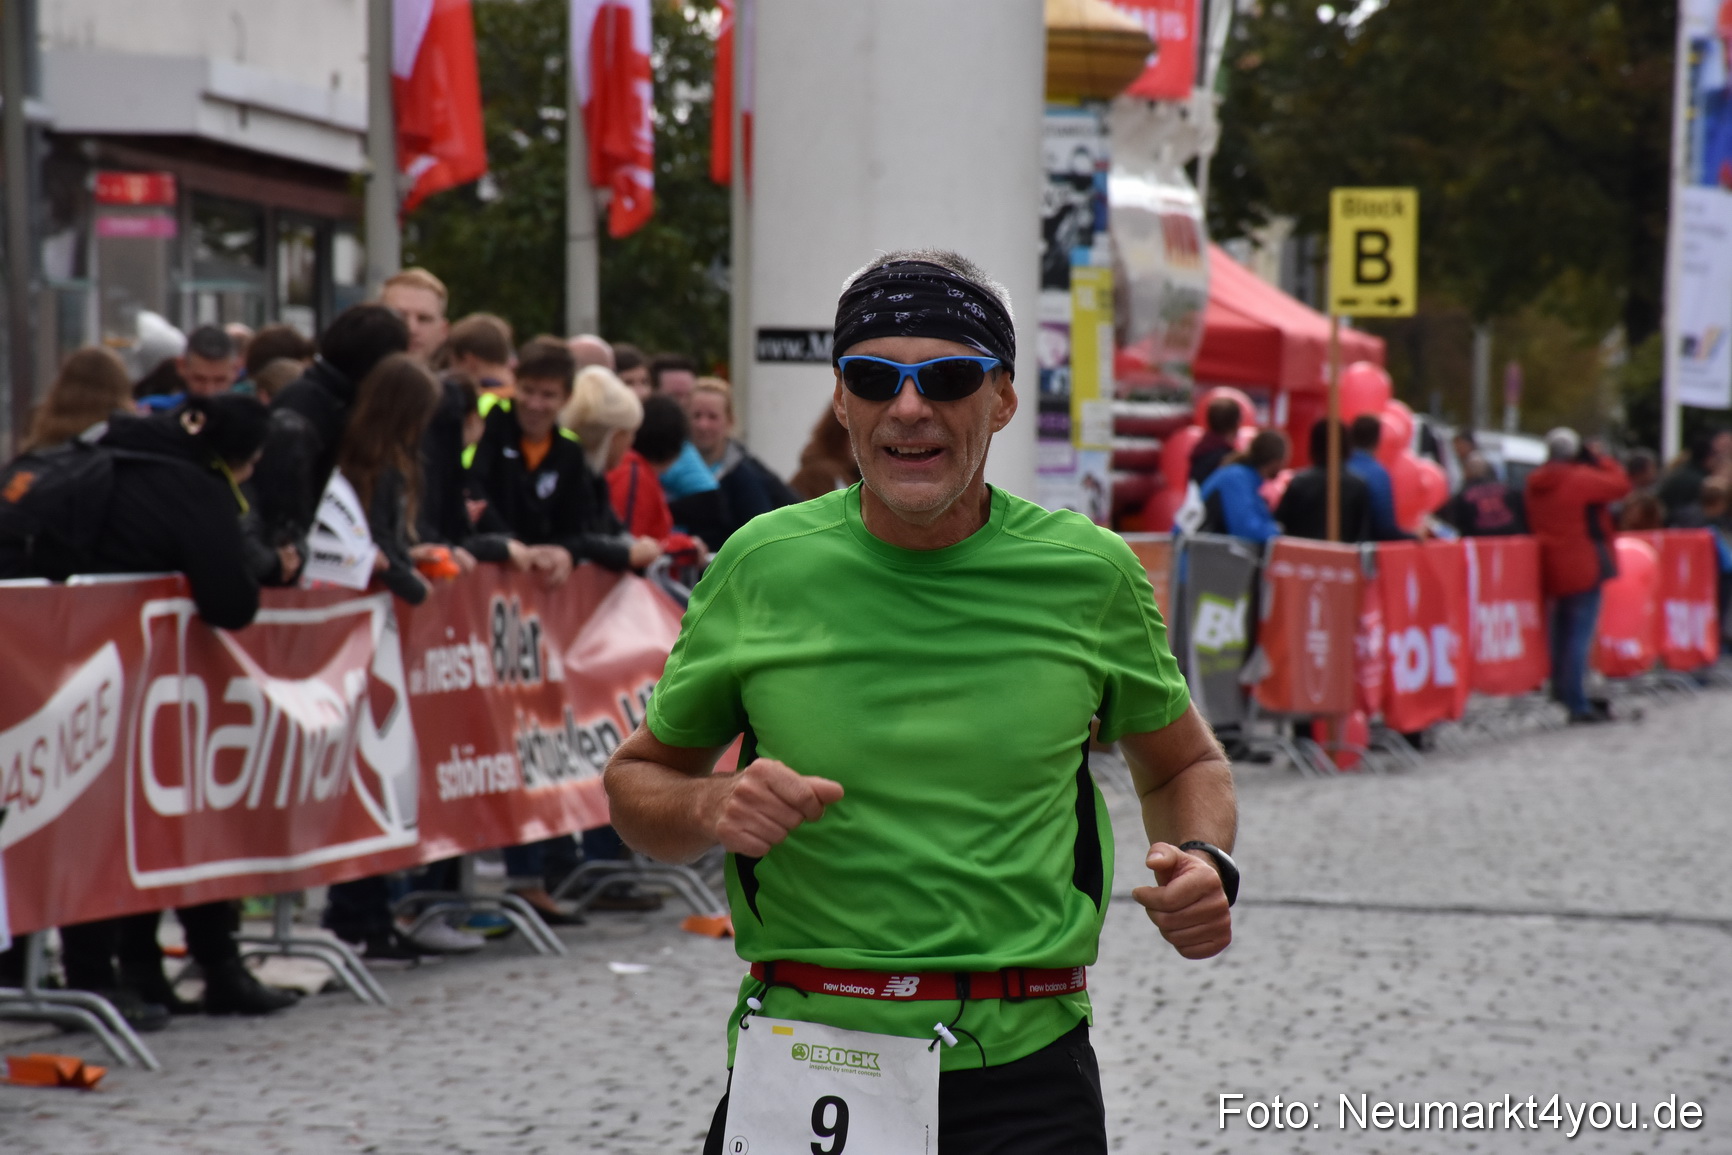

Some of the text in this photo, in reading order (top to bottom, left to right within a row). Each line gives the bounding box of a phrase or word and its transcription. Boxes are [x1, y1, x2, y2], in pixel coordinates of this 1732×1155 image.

[1342, 196, 1405, 218] Block
[1354, 228, 1394, 286] B
[823, 982, 839, 991] new
[840, 983, 875, 996] balance
[1030, 984, 1044, 992] new
[1045, 982, 1067, 991] balance
[810, 1044, 881, 1071] BOCK
[809, 1062, 881, 1077] inspired by smart concepts
[810, 1095, 850, 1155] 9
[735, 1141, 743, 1153] D
